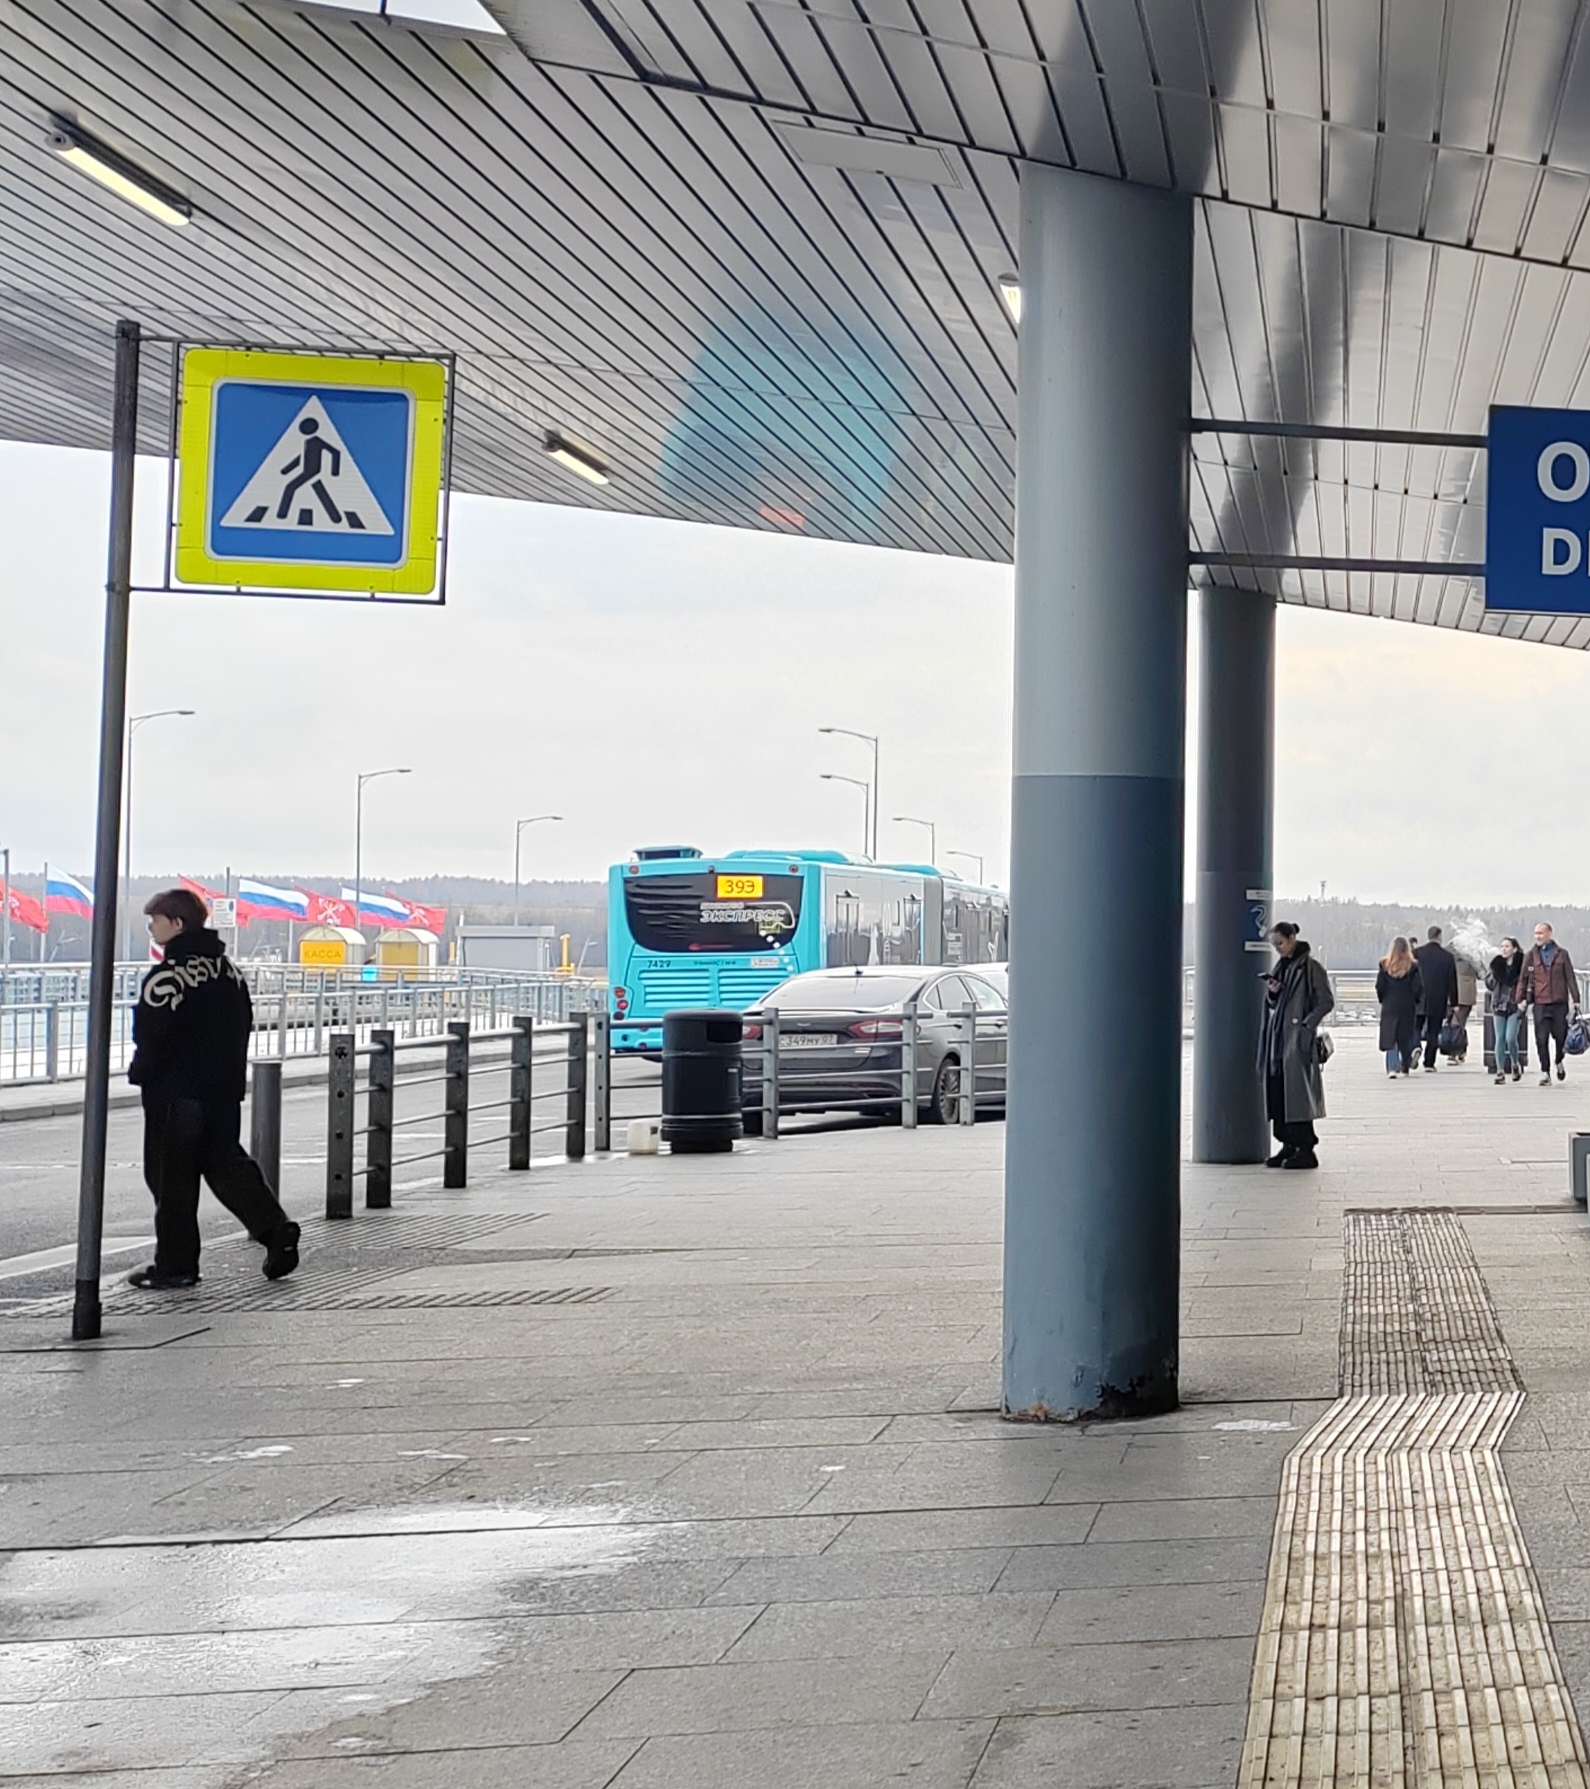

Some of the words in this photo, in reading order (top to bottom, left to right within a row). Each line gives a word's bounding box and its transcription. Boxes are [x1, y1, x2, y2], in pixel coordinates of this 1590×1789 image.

[700, 909, 787, 923] ЭКСПРЕСС
[304, 949, 342, 960] КАССА
[647, 959, 672, 969] 7429
